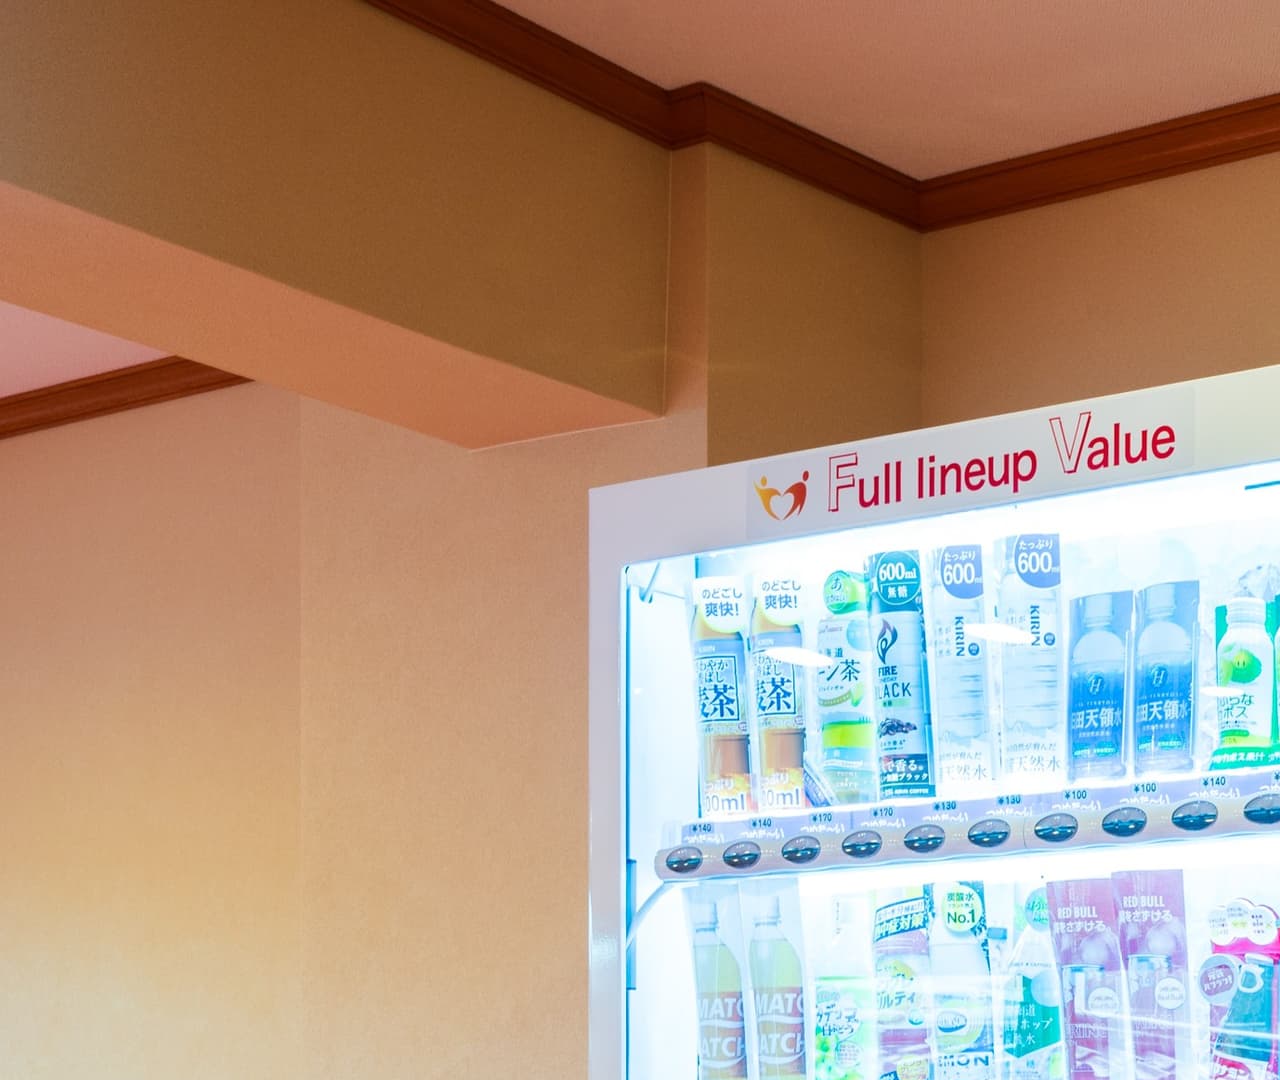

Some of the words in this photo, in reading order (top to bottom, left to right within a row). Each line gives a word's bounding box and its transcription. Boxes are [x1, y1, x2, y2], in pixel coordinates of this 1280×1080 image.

[828, 452, 902, 512] Full
[917, 449, 1038, 499] lineup
[1049, 412, 1176, 474] Value
[878, 562, 917, 582] 600ml
[762, 579, 802, 592] のどごし
[701, 587, 743, 599] のどごし
[764, 593, 798, 610] 爽快!
[705, 601, 740, 617] 爽快!
[954, 616, 967, 657] KIRIN
[879, 665, 898, 676] FIRE
[1133, 782, 1157, 793] ¥100
[1123, 896, 1138, 908] RED
[1140, 895, 1165, 908] BULL
[947, 910, 976, 925] No.1
[1057, 907, 1073, 919] RED
[1074, 906, 1098, 919] BULL
